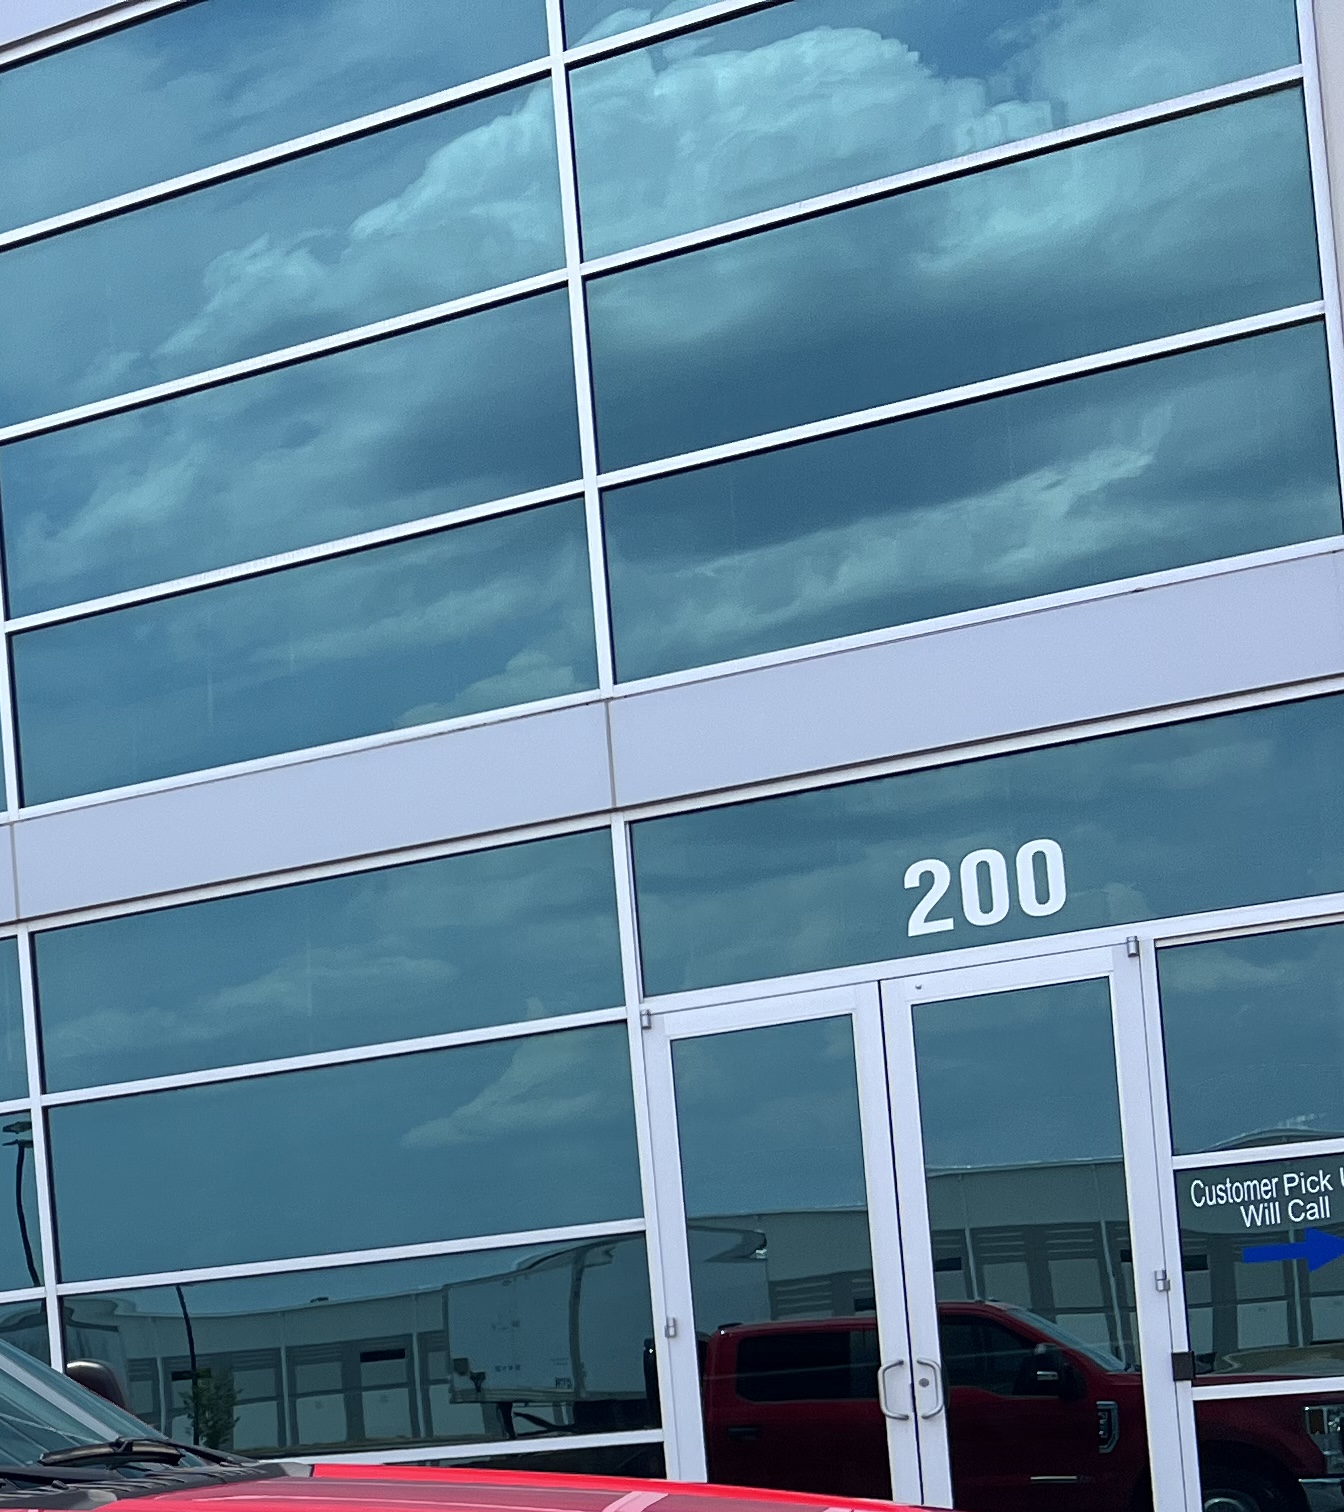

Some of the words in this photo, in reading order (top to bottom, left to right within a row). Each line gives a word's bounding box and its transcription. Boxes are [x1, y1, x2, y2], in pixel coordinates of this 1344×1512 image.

[903, 838, 1067, 936] 200
[1190, 1177, 1279, 1208] Customer
[1283, 1169, 1334, 1197] Pick
[1240, 1201, 1281, 1228] Will
[1288, 1195, 1331, 1222] Call
